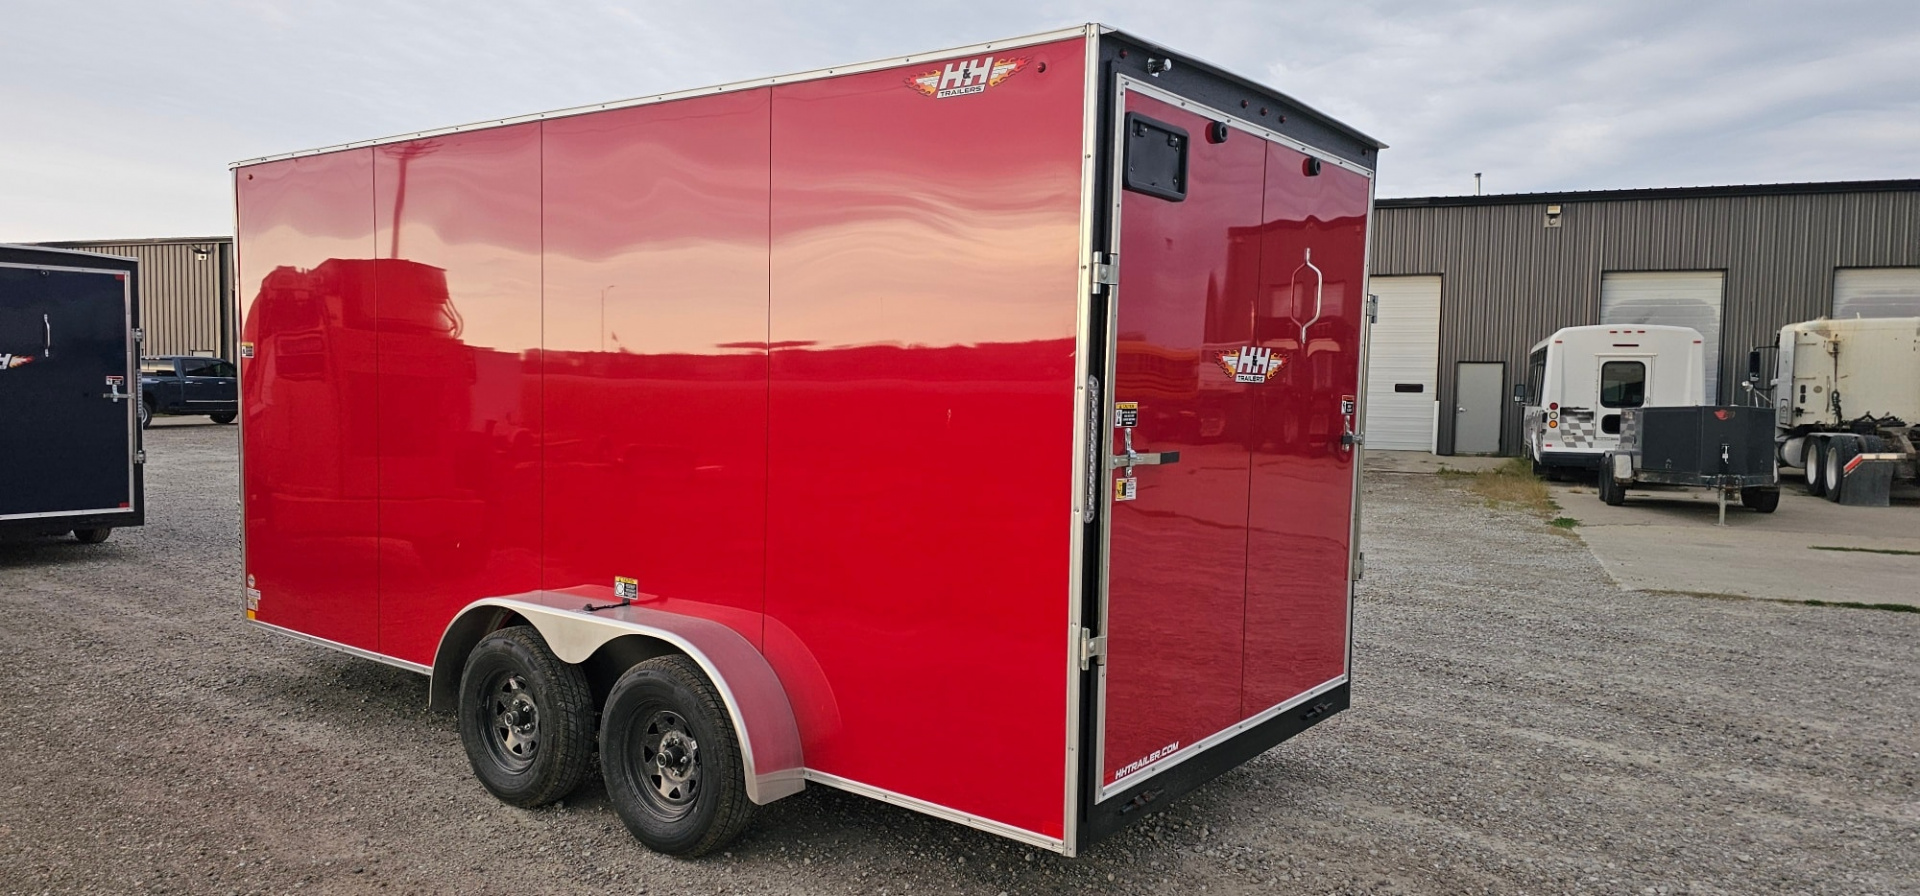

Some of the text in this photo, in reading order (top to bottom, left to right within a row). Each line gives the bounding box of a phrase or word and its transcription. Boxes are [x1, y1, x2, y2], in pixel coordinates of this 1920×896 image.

[939, 57, 994, 89] H&H
[940, 86, 982, 97] TRAILERS
[1115, 741, 1179, 780] HHTRAILER.COM
